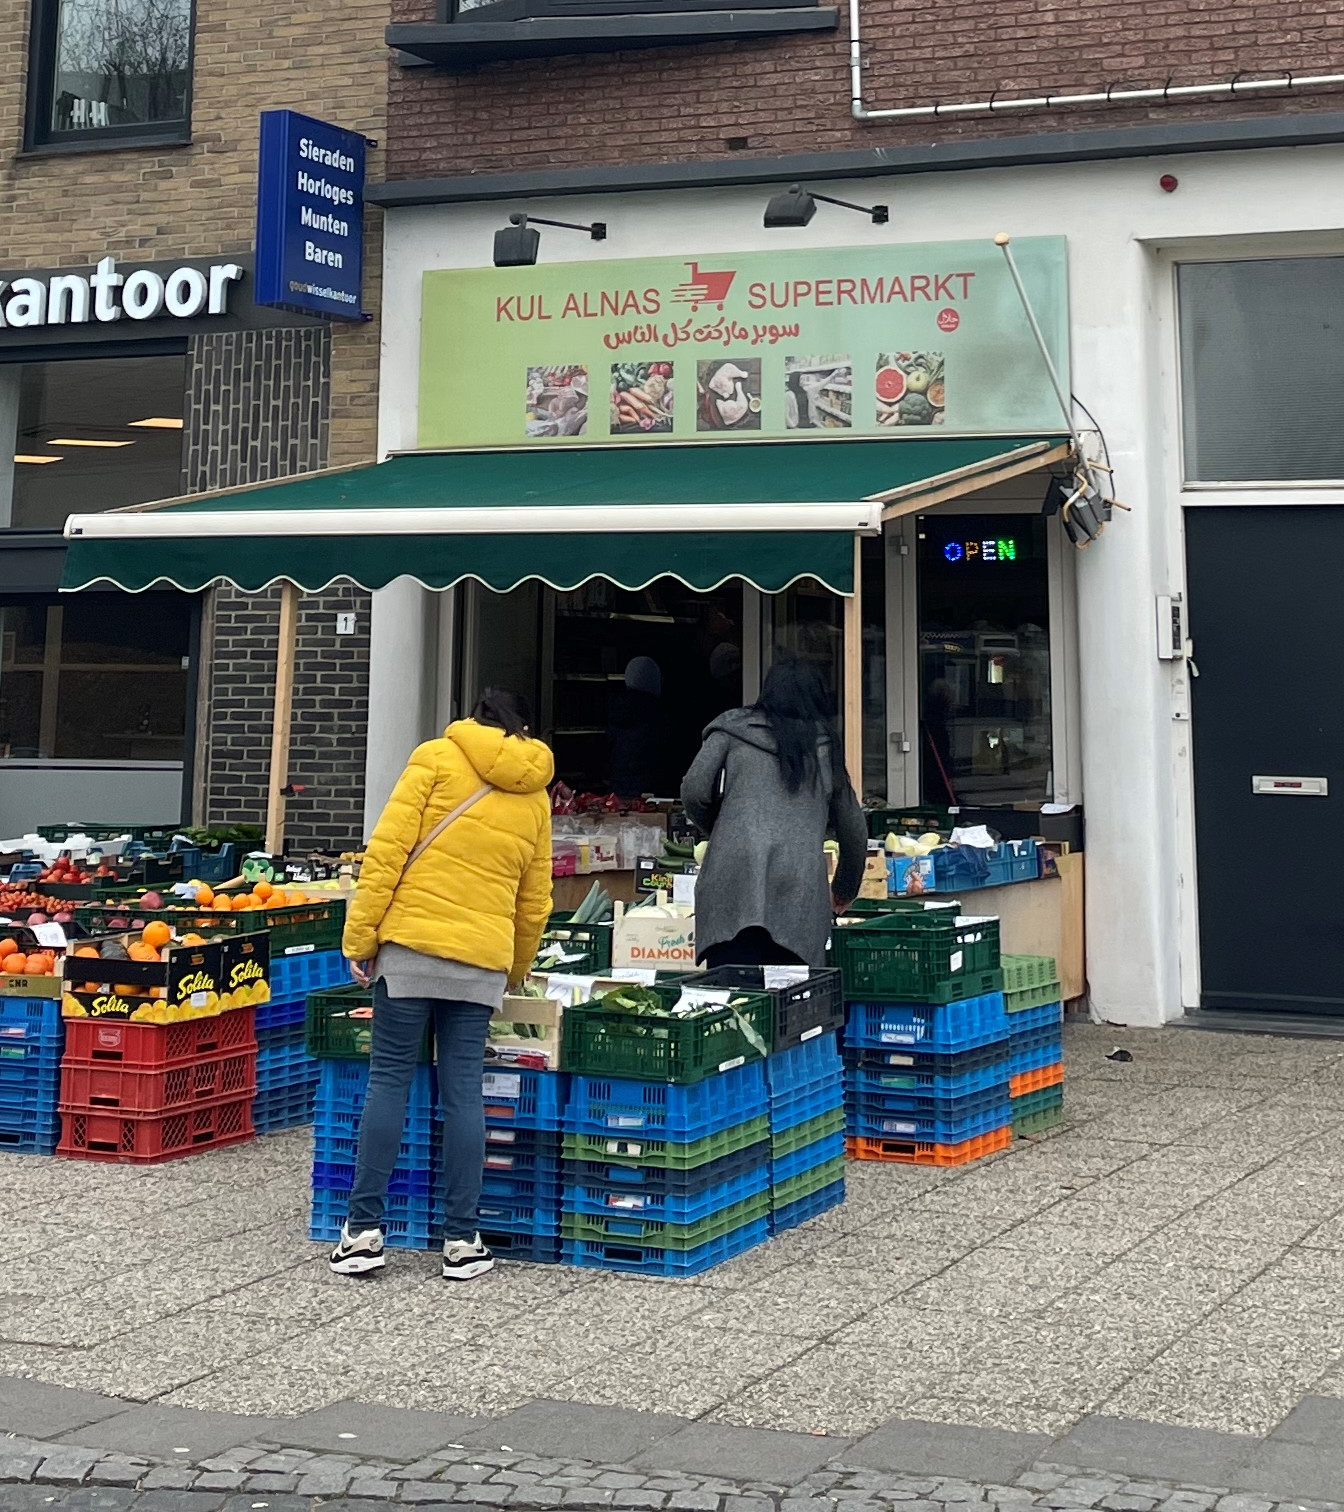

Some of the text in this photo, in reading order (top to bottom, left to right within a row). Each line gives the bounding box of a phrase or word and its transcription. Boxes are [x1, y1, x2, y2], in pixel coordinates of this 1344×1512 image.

[299, 138, 355, 173] Sieraden
[297, 170, 354, 206] Horloges
[301, 206, 348, 237] Munten
[305, 240, 343, 269] Baren
[496, 272, 976, 322] KUL ALNAS SUPERMARKT
[943, 540, 1016, 561] OPEN
[343, 616, 348, 631] 1
[631, 947, 694, 960] DIAMON
[176, 970, 215, 1000] Solita
[229, 959, 264, 988] Solita
[91, 994, 130, 1016] Solita
